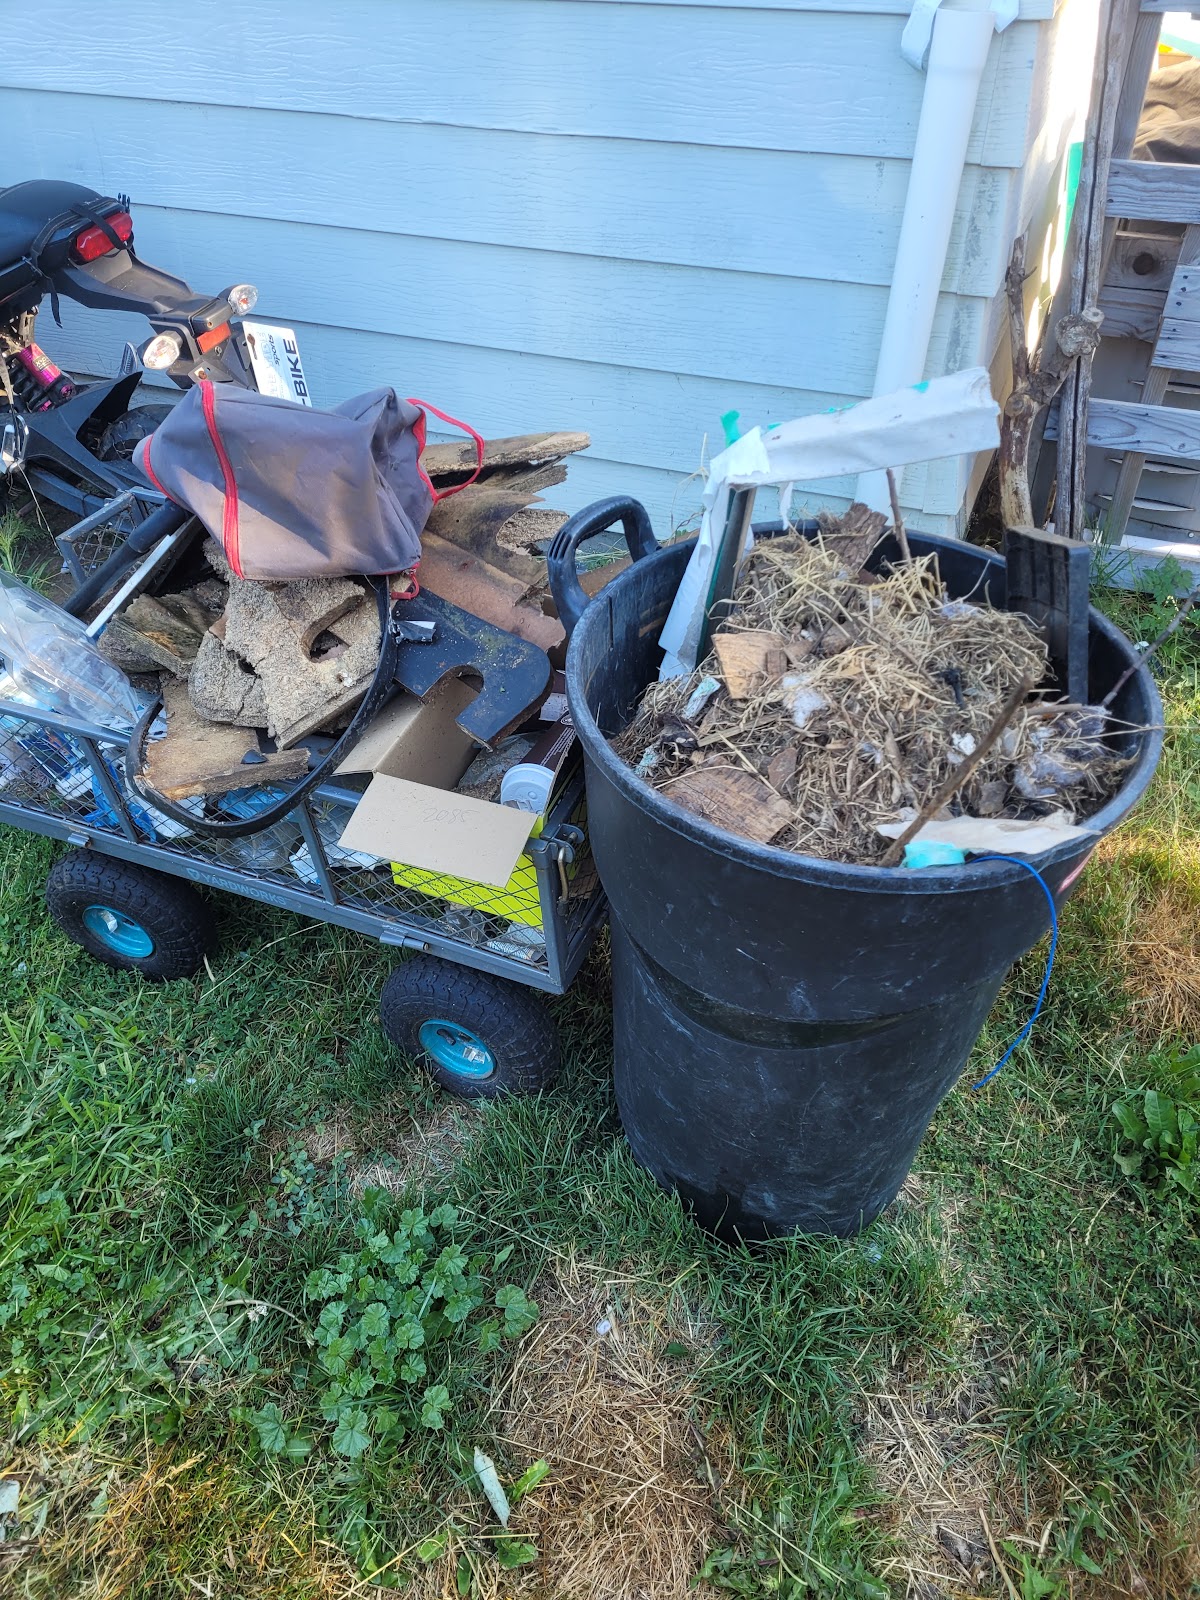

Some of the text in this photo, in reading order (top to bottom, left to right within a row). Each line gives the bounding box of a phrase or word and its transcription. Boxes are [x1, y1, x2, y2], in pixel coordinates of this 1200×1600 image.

[268, 334, 280, 366] sports
[423, 808, 480, 825] 2085
[201, 872, 287, 906] YARDWORKS
